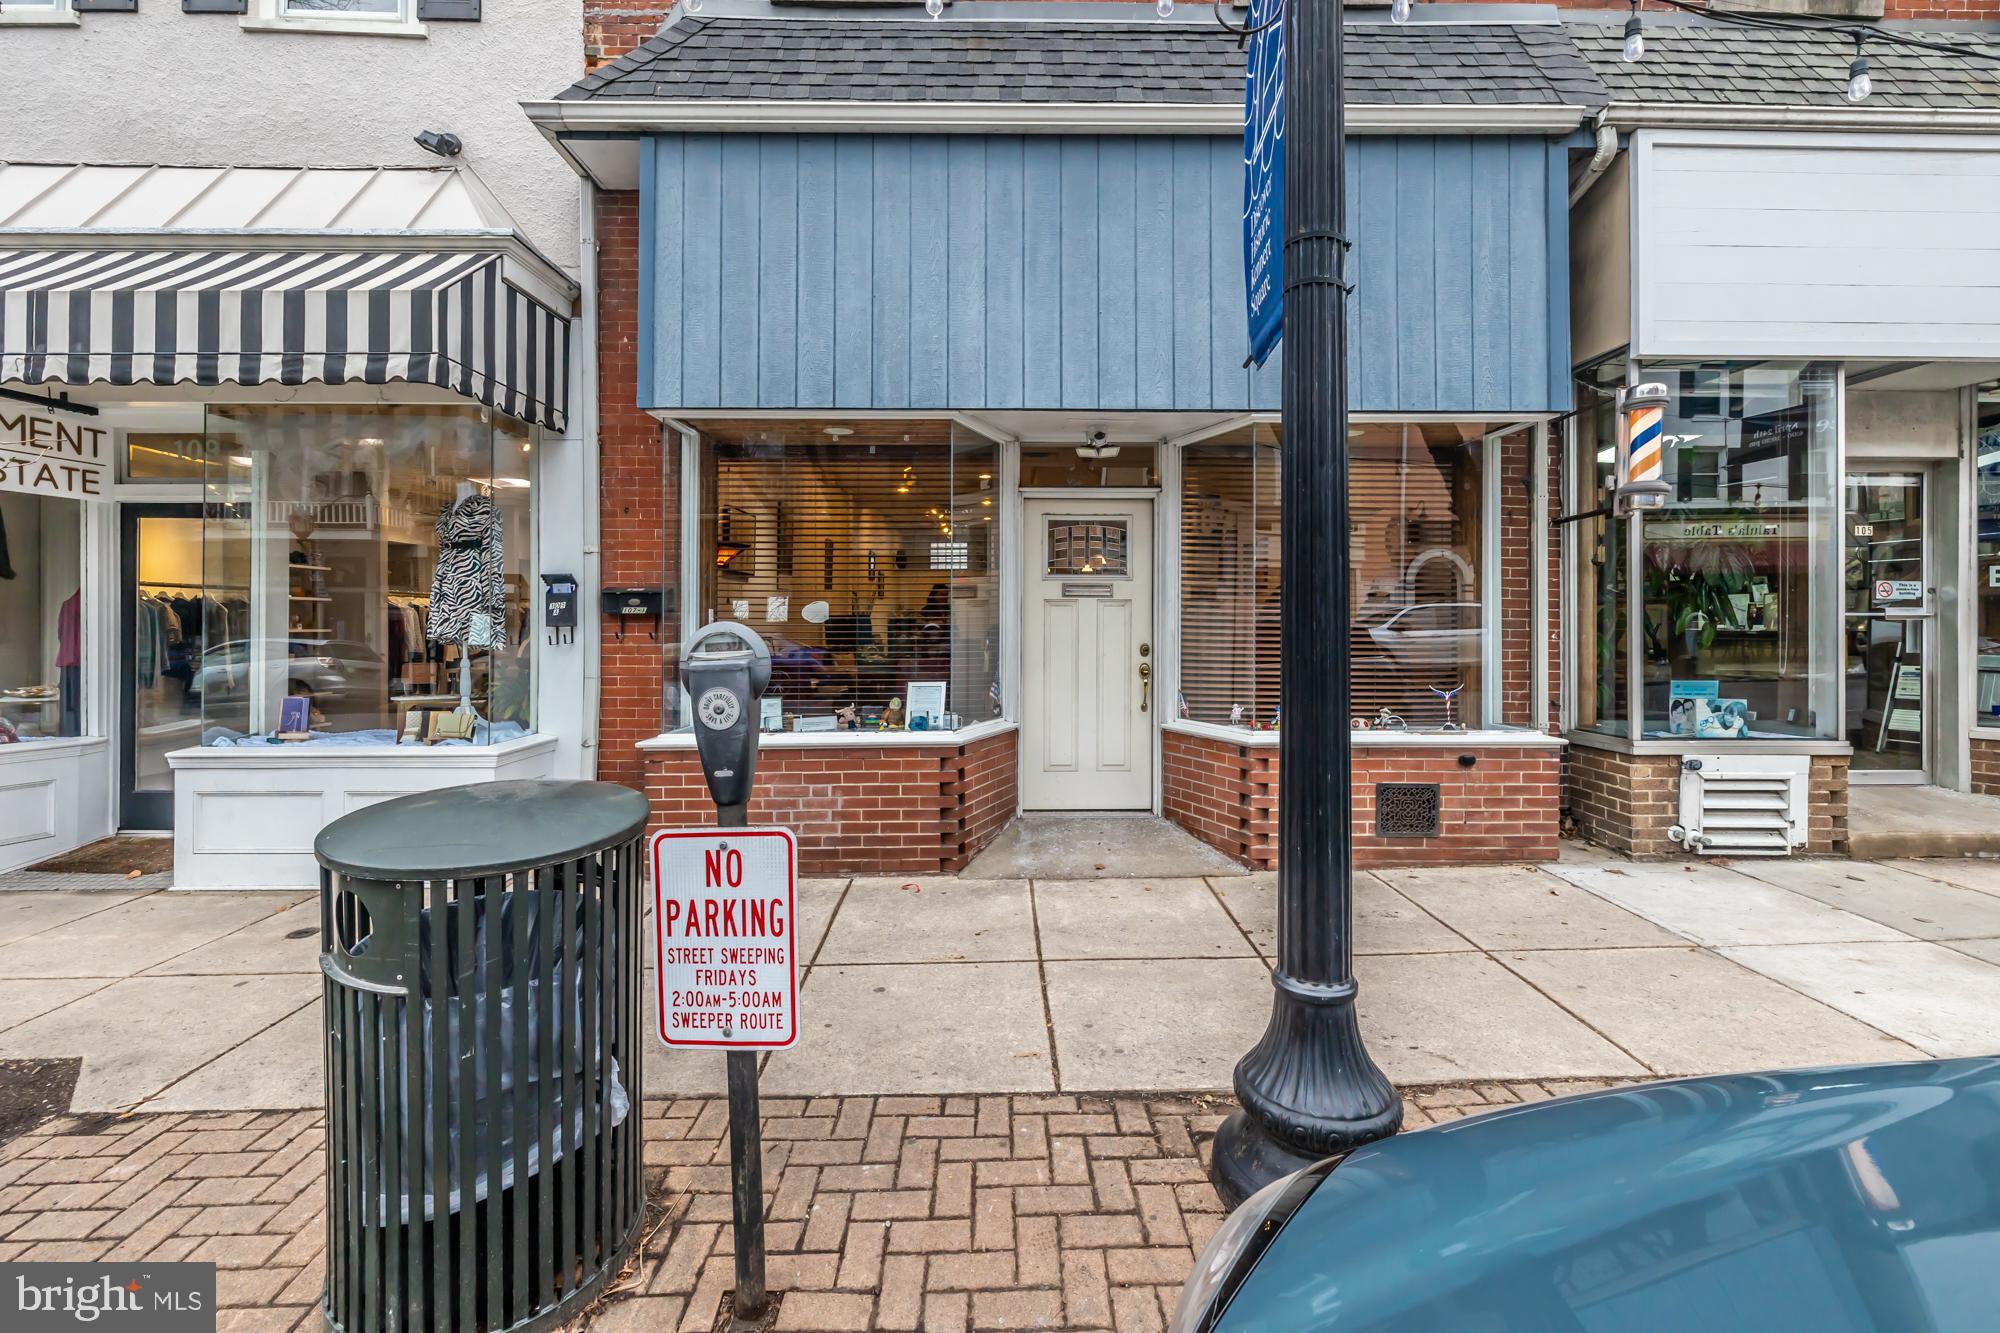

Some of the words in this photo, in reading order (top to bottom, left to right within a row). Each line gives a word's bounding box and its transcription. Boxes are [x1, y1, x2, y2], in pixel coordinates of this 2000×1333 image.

[1251, 274, 1270, 317] Square
[0, 413, 107, 458] MENT
[1855, 526, 1872, 536] 105
[713, 693, 735, 709] CAREFULLY
[705, 713, 718, 725] SAVE
[705, 849, 742, 888] NO
[666, 898, 784, 938] PARKING
[668, 948, 714, 965] STREET
[721, 948, 785, 965] SWEEPING
[696, 969, 757, 986] FRIDAYS
[672, 1012, 733, 1029] SWEEPER
[740, 1012, 784, 1029] ROUTE
